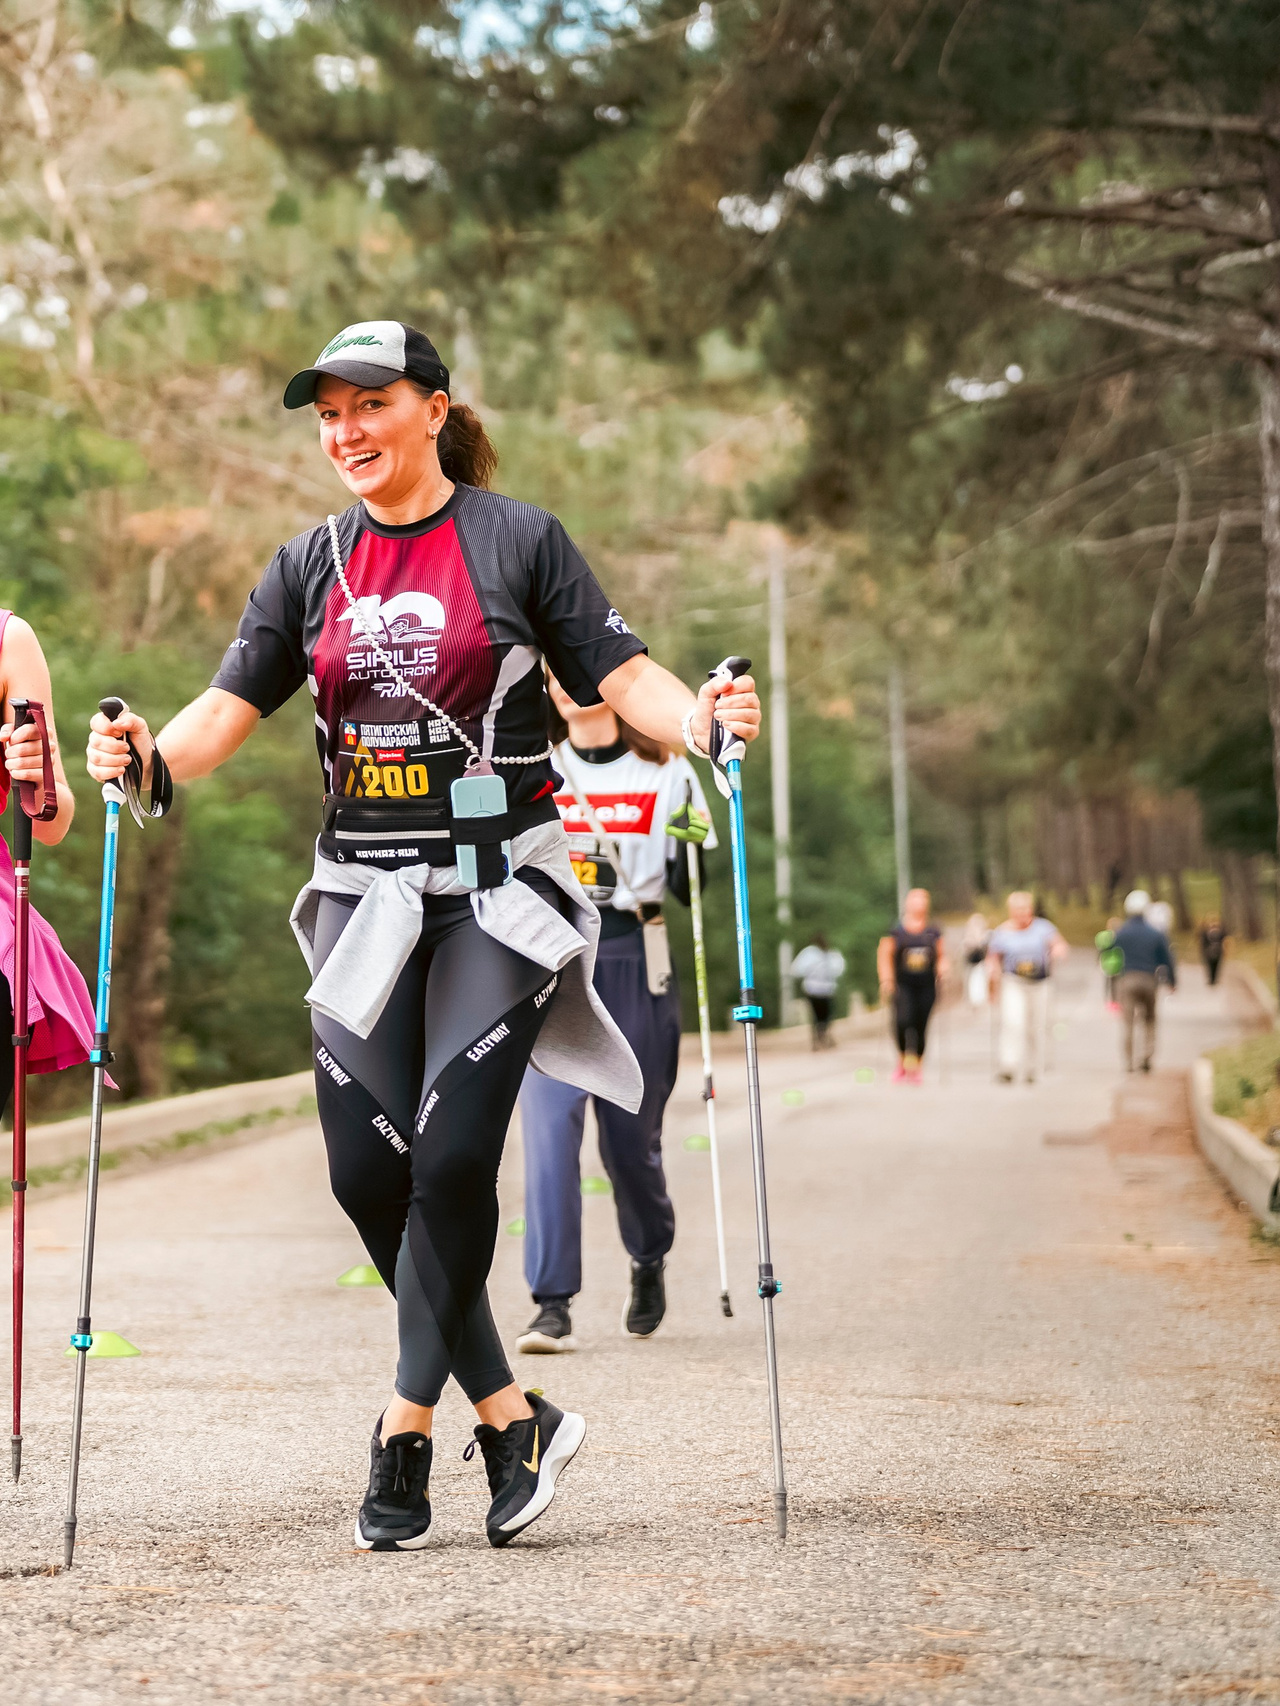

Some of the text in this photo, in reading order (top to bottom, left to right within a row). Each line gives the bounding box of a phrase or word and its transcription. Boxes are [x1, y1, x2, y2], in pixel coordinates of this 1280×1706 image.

[346, 646, 438, 670] SIRIUS
[347, 664, 437, 682] AUTODROM
[360, 722, 419, 737] ПЯТИГОРСКИЙ
[361, 734, 421, 748] ПОЛУМАРАФОН
[362, 763, 430, 797] 200
[534, 974, 558, 1009] EAZYWAY
[466, 1022, 511, 1062] EAZYWAY
[316, 1047, 351, 1087] EAZYWAY
[417, 1090, 440, 1134] EAZYWAY
[371, 1113, 410, 1155] EAZYWAY
